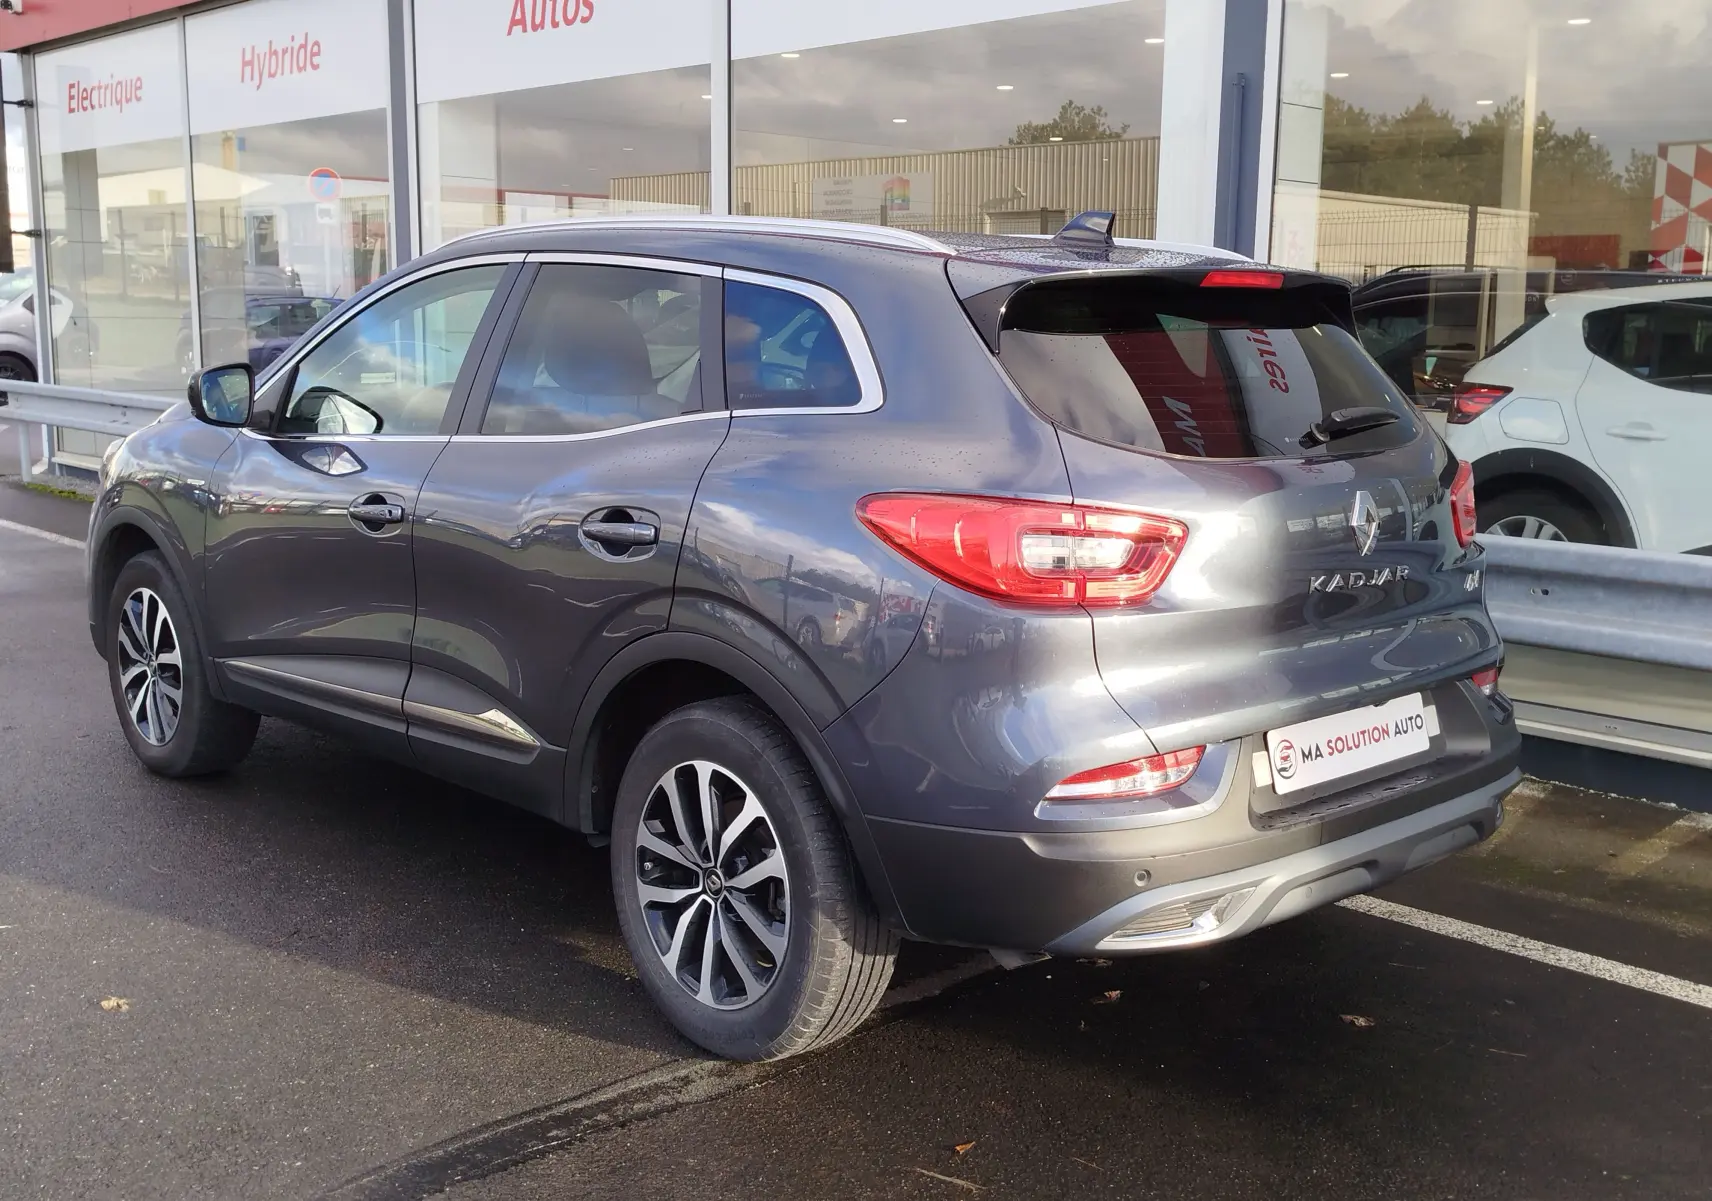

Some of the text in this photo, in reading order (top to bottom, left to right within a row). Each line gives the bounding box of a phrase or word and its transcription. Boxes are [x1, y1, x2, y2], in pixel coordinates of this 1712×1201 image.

[507, 0, 594, 36] Autos
[240, 31, 322, 91] Hybride
[67, 73, 143, 114] Electrique
[1309, 564, 1410, 594] KADJAR
[1300, 713, 1424, 764] MA SOLUTION AUTO
